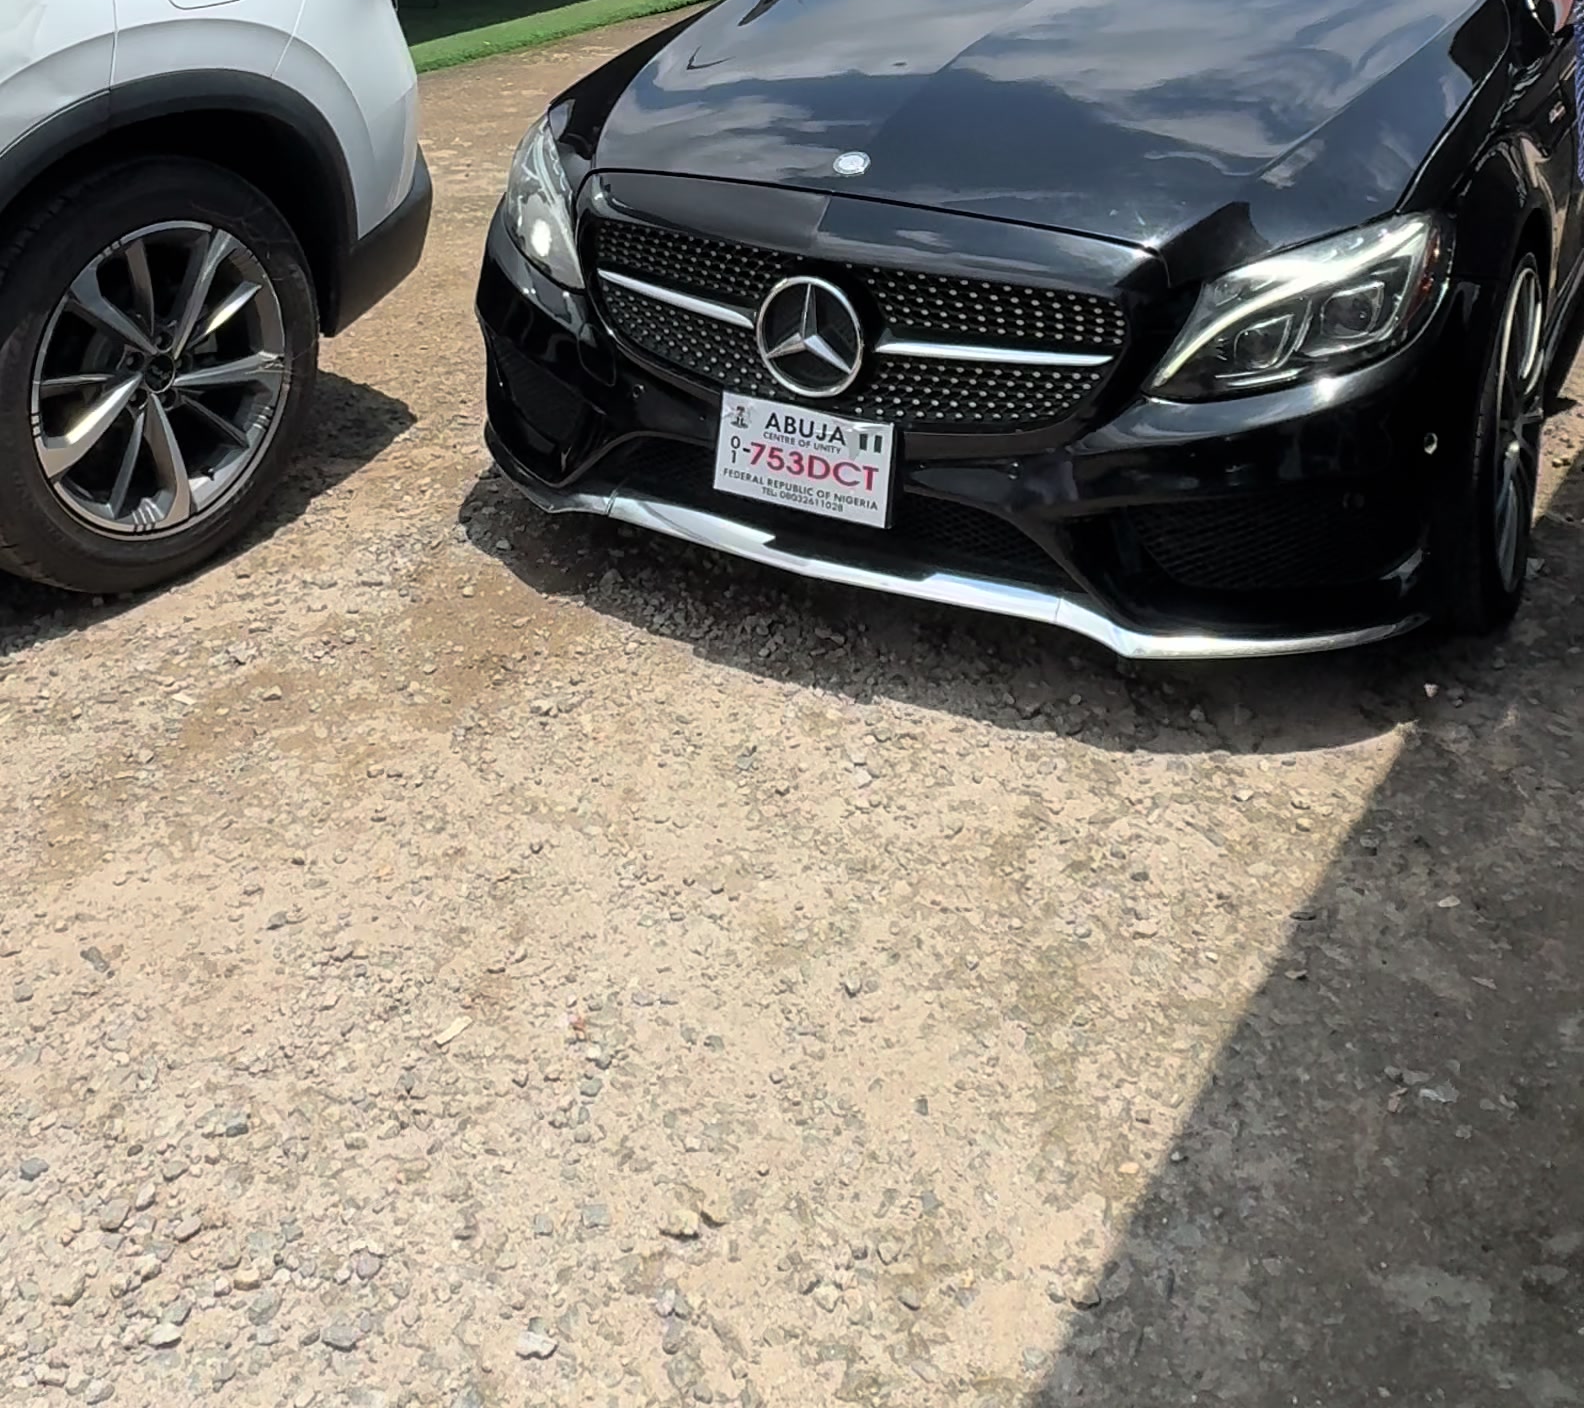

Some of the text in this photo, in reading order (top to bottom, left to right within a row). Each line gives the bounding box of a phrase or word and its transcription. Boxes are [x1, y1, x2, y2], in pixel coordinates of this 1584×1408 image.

[763, 431, 841, 455] CENTRE OF UNITY
[765, 412, 846, 446] ABUJA
[723, 467, 878, 511] FEDERAL REPUBLIC OF NIGERIA
